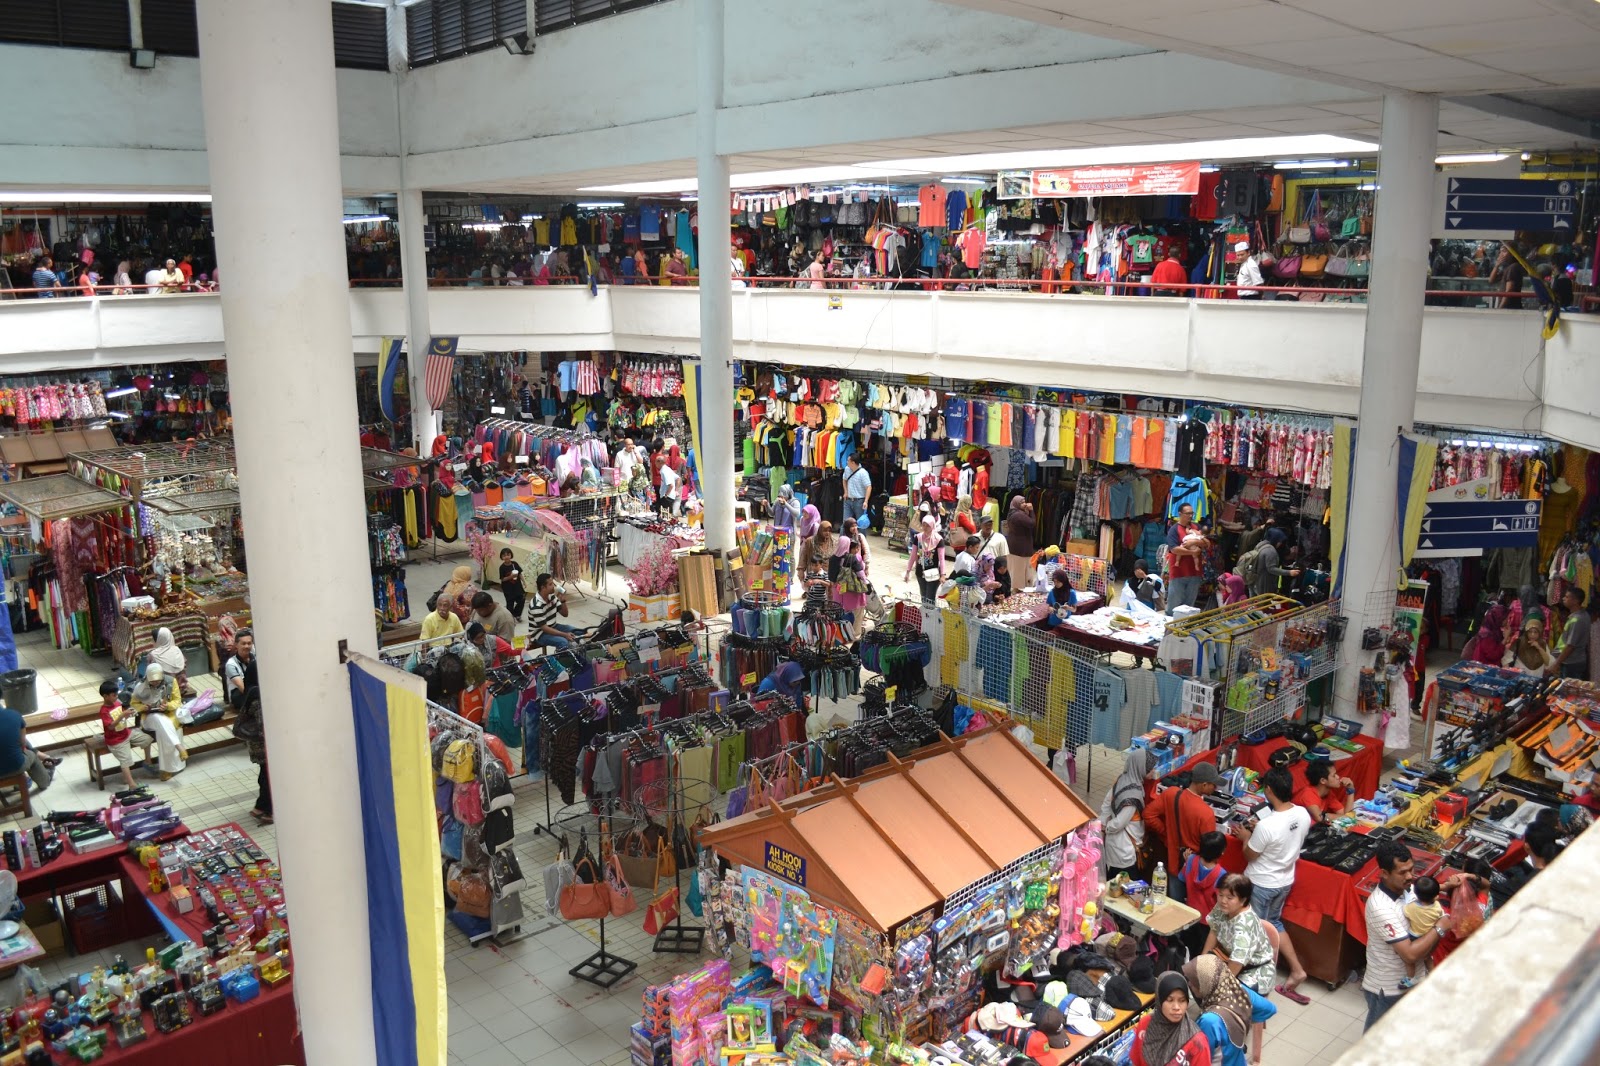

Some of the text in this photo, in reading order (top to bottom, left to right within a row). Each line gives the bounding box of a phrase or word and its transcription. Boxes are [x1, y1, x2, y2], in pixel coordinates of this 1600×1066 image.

[1094, 695, 1109, 712] 4
[769, 845, 780, 859] AH
[767, 859, 784, 876] KIOSK
[786, 869, 797, 881] NO.
[798, 875, 803, 884] 2
[1384, 923, 1396, 938] 3
